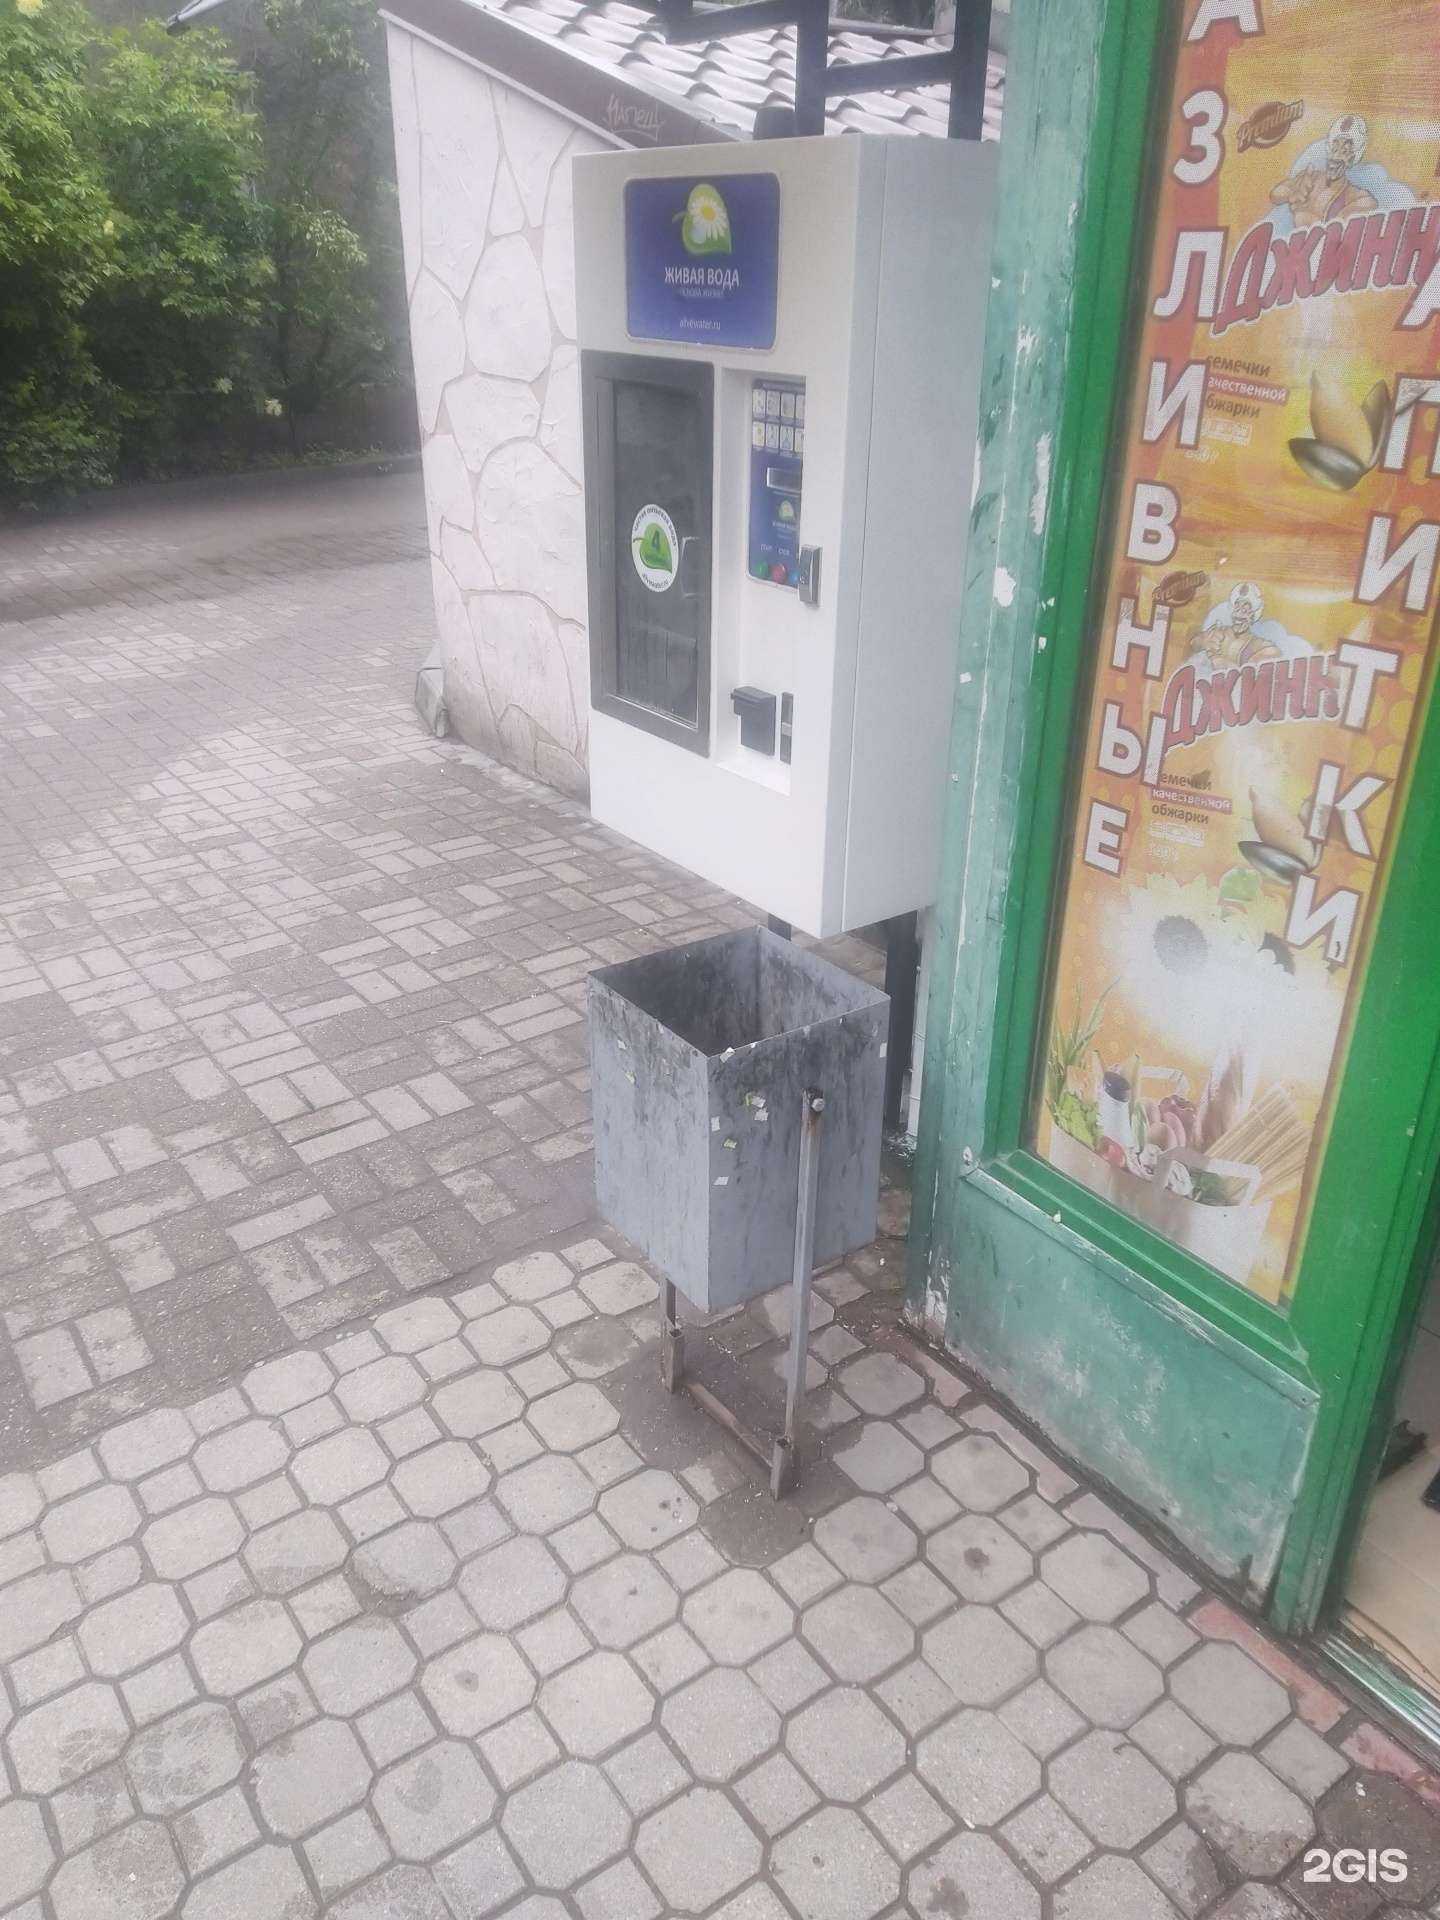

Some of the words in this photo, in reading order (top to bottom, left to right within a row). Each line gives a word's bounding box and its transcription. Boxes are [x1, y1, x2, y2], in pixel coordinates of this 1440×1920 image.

[664, 266, 705, 286] ЖИВАЯ
[707, 268, 740, 291] ВОДА
[1207, 377, 1287, 402] ачественной
[1206, 393, 1261, 418] бжарки
[1160, 772, 1212, 791] емечи
[1152, 803, 1209, 825] обжарки
